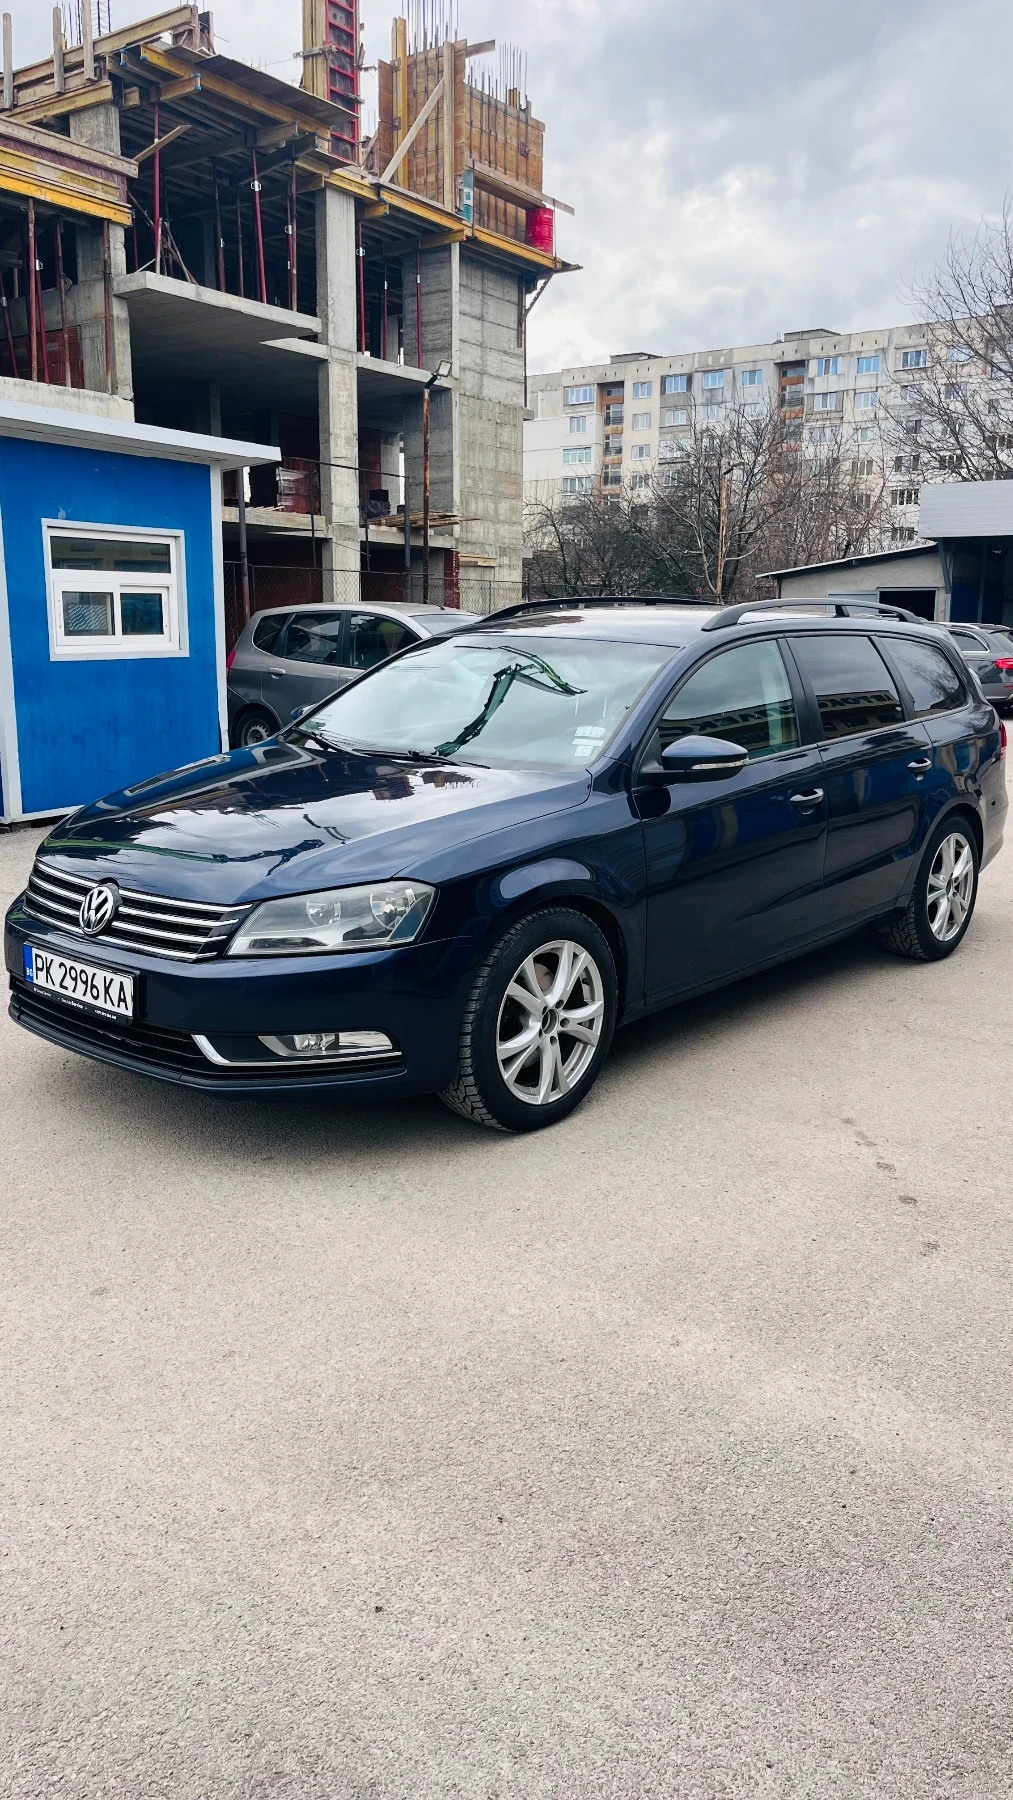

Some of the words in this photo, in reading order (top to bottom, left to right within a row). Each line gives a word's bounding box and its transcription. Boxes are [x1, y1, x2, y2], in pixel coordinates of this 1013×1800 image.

[34, 952, 56, 987] PK
[58, 961, 100, 1001] 2996
[103, 975, 129, 1011] KA
